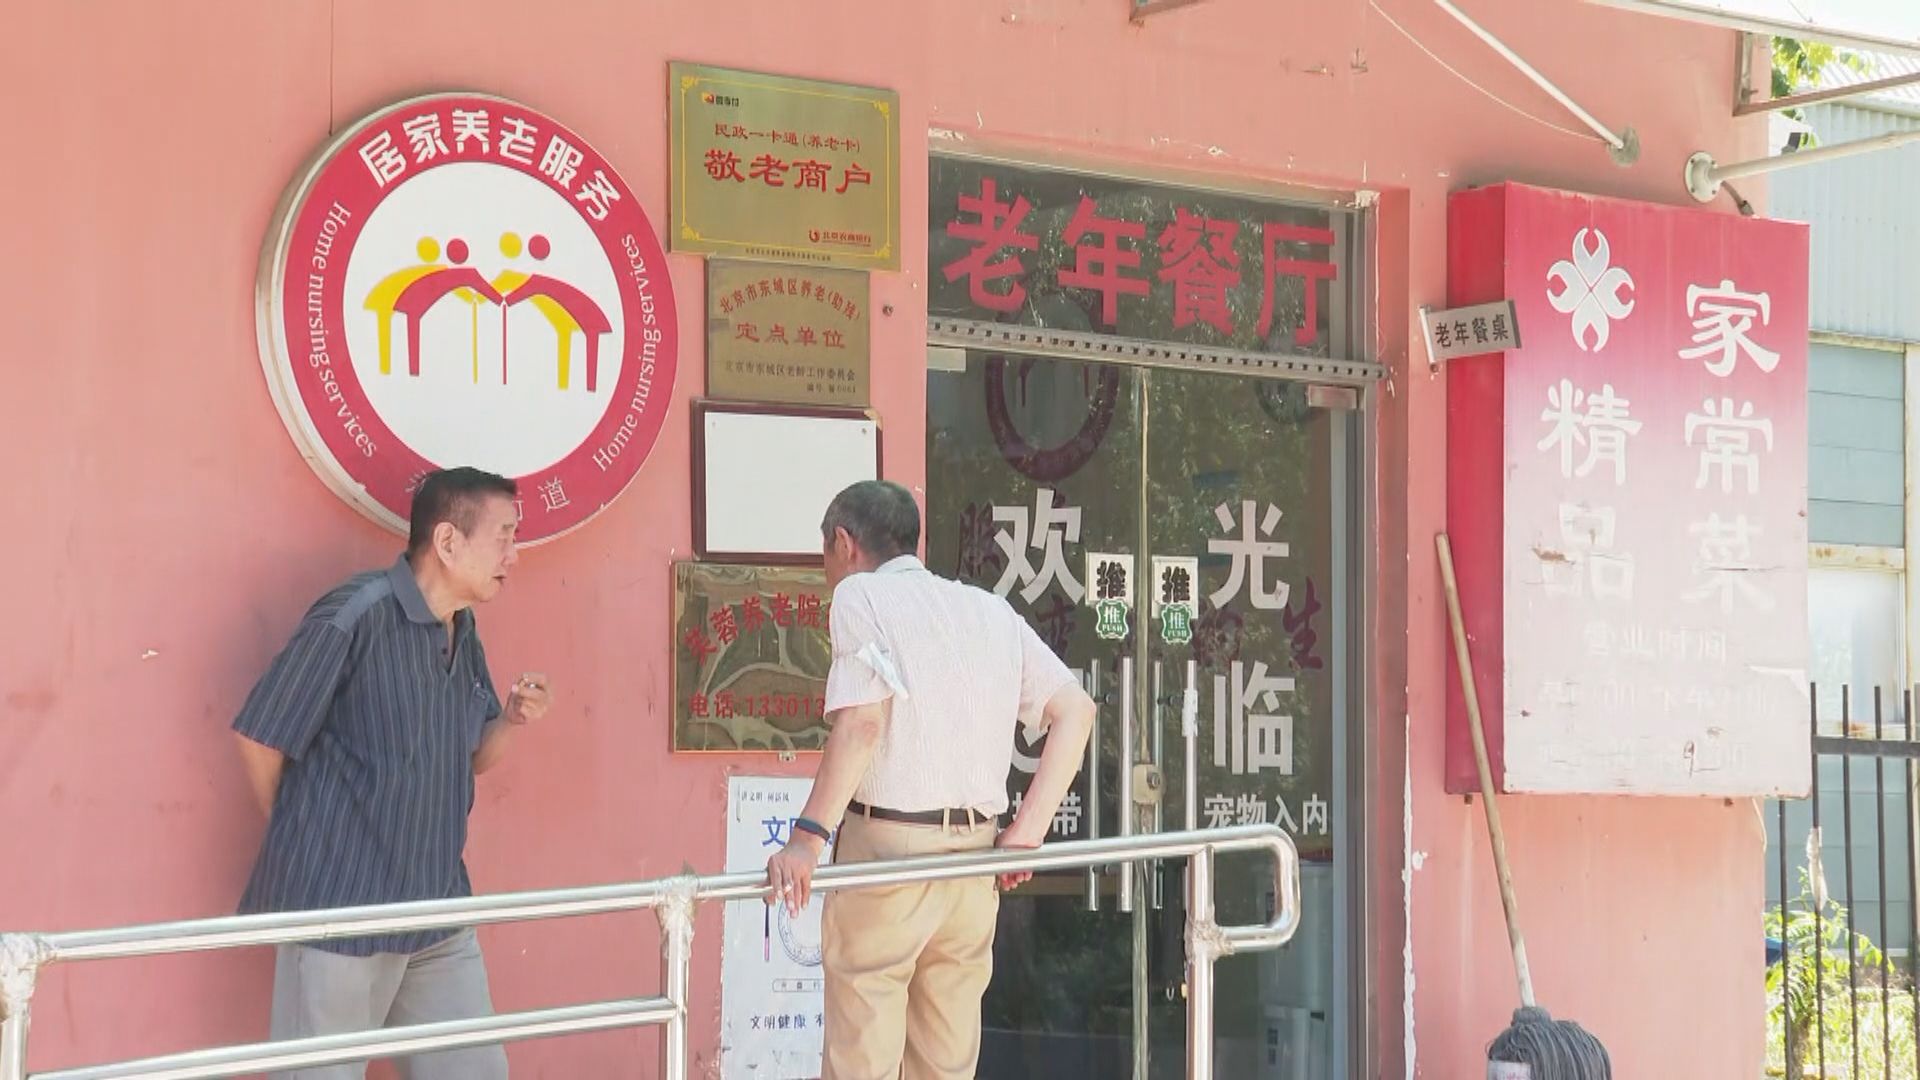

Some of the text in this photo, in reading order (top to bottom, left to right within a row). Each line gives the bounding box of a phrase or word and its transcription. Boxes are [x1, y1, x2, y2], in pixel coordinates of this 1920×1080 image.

[358, 109, 621, 221] 居家养老服务
[704, 149, 871, 194] 敬老商户
[943, 177, 1337, 345] 老年餐厅
[308, 201, 377, 457] Home nursing services
[591, 233, 661, 472] Home nursing services
[735, 323, 846, 349] 定点单位
[1435, 313, 1508, 347] 老年餐桌
[1678, 280, 1780, 617] 家常菜
[1537, 378, 1643, 601] 精品
[1097, 561, 1126, 599] 推
[1162, 566, 1191, 603] 推
[684, 592, 830, 667] 芙蓉养老院
[1104, 606, 1121, 623] 推
[1169, 611, 1185, 629] 推
[1207, 500, 1296, 775] 光临
[1203, 793, 1328, 835] 宠物入内
